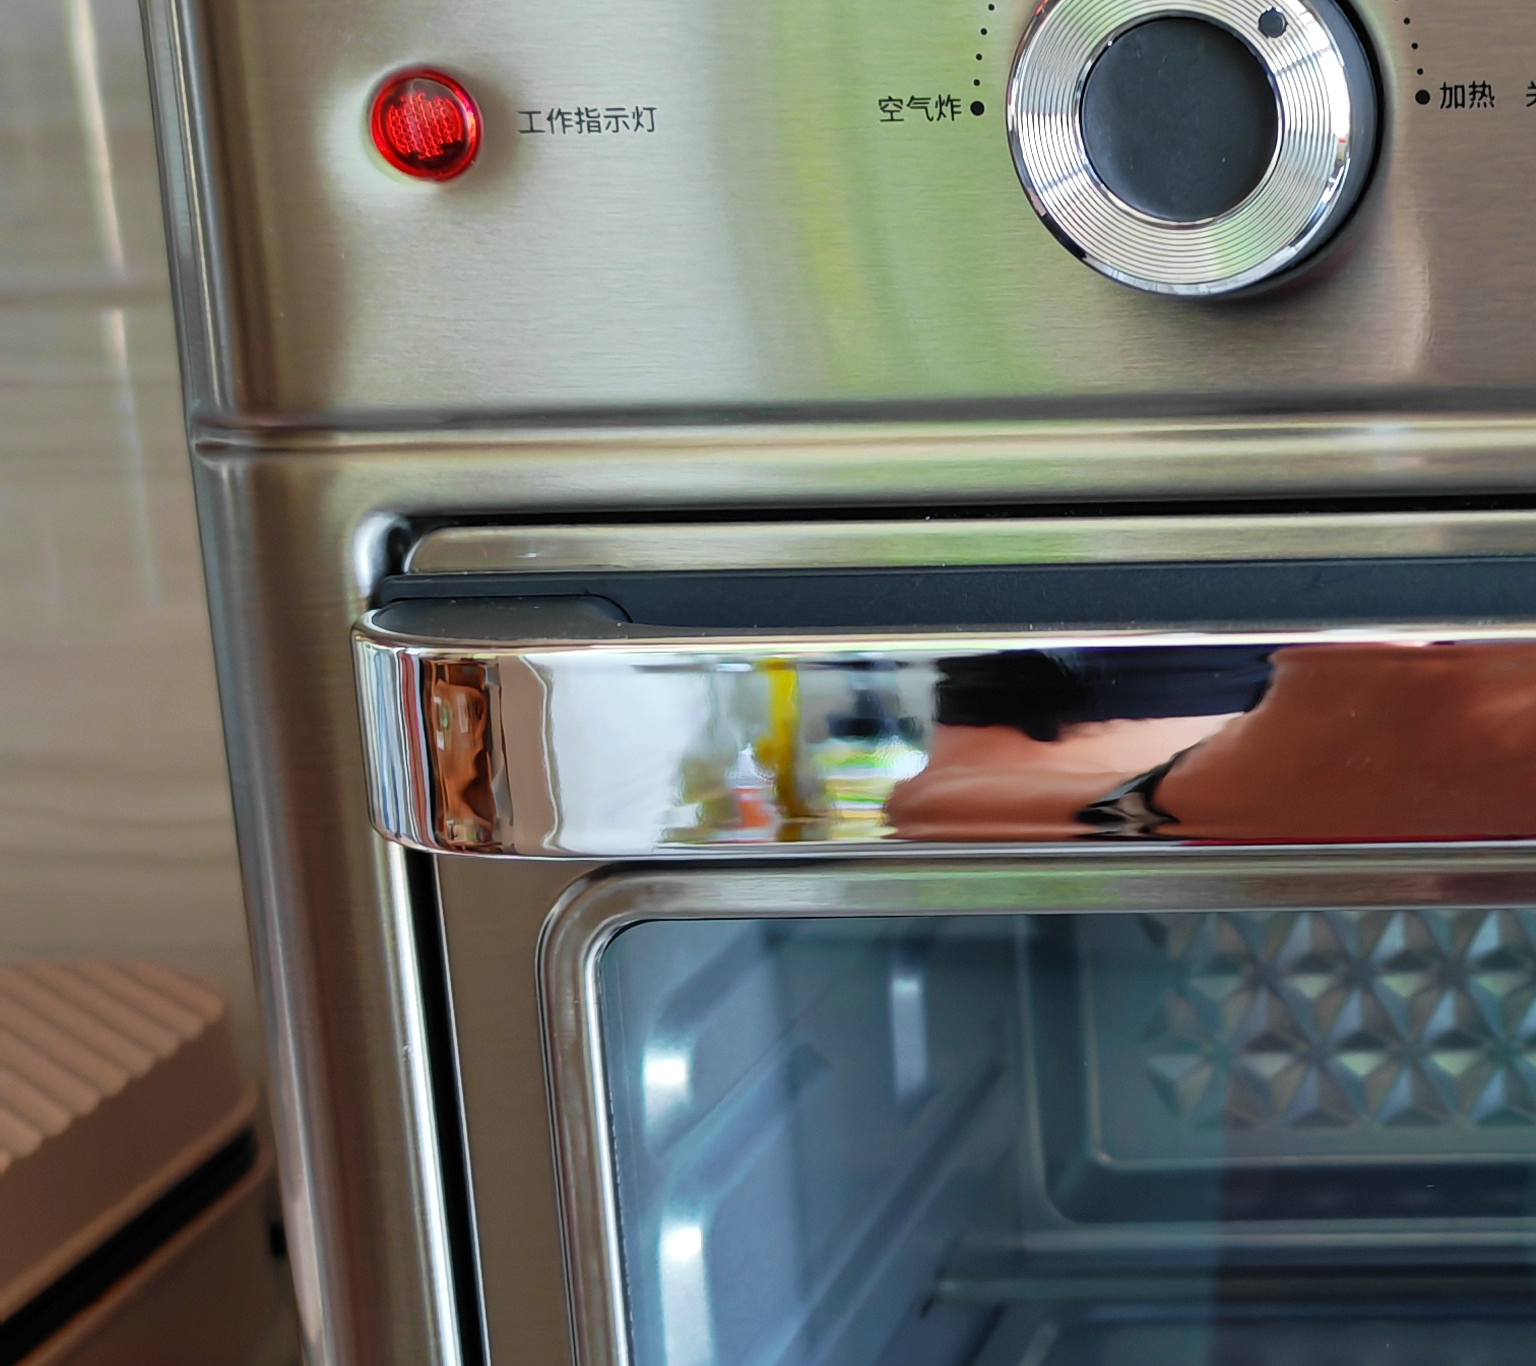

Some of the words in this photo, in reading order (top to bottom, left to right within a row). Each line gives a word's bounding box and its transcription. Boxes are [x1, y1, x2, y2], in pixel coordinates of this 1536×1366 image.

[877, 95, 963, 124] 空气炸
[1439, 81, 1496, 110] 加热
[517, 106, 658, 135] 工作指示灯
